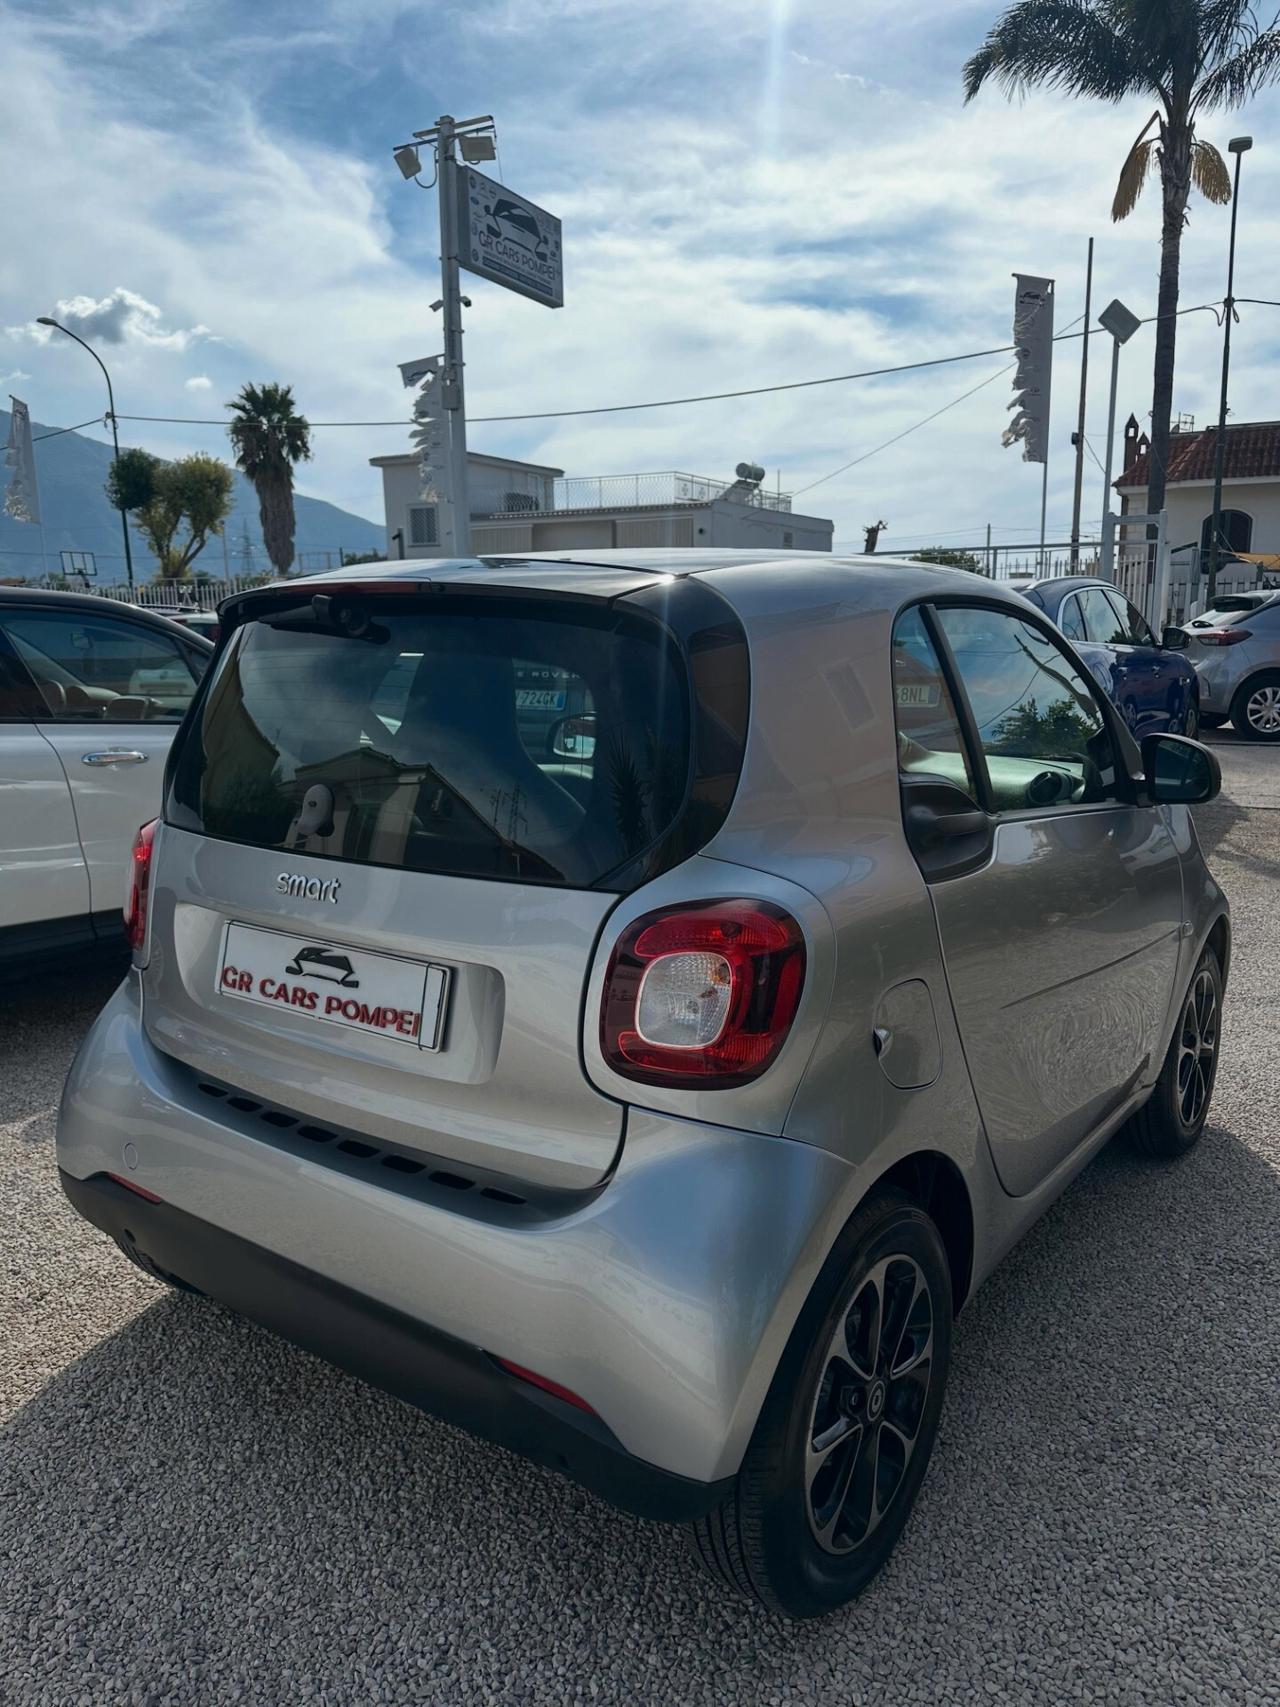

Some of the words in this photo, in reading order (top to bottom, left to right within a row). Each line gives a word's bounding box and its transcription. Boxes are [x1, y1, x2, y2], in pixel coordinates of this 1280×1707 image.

[479, 230, 494, 251] GR
[495, 240, 520, 264] CARS
[521, 255, 556, 280] POMPEI
[275, 872, 342, 904] smart
[222, 966, 254, 993] GR
[258, 978, 320, 1011] CARS
[324, 996, 422, 1038] POMPEI
